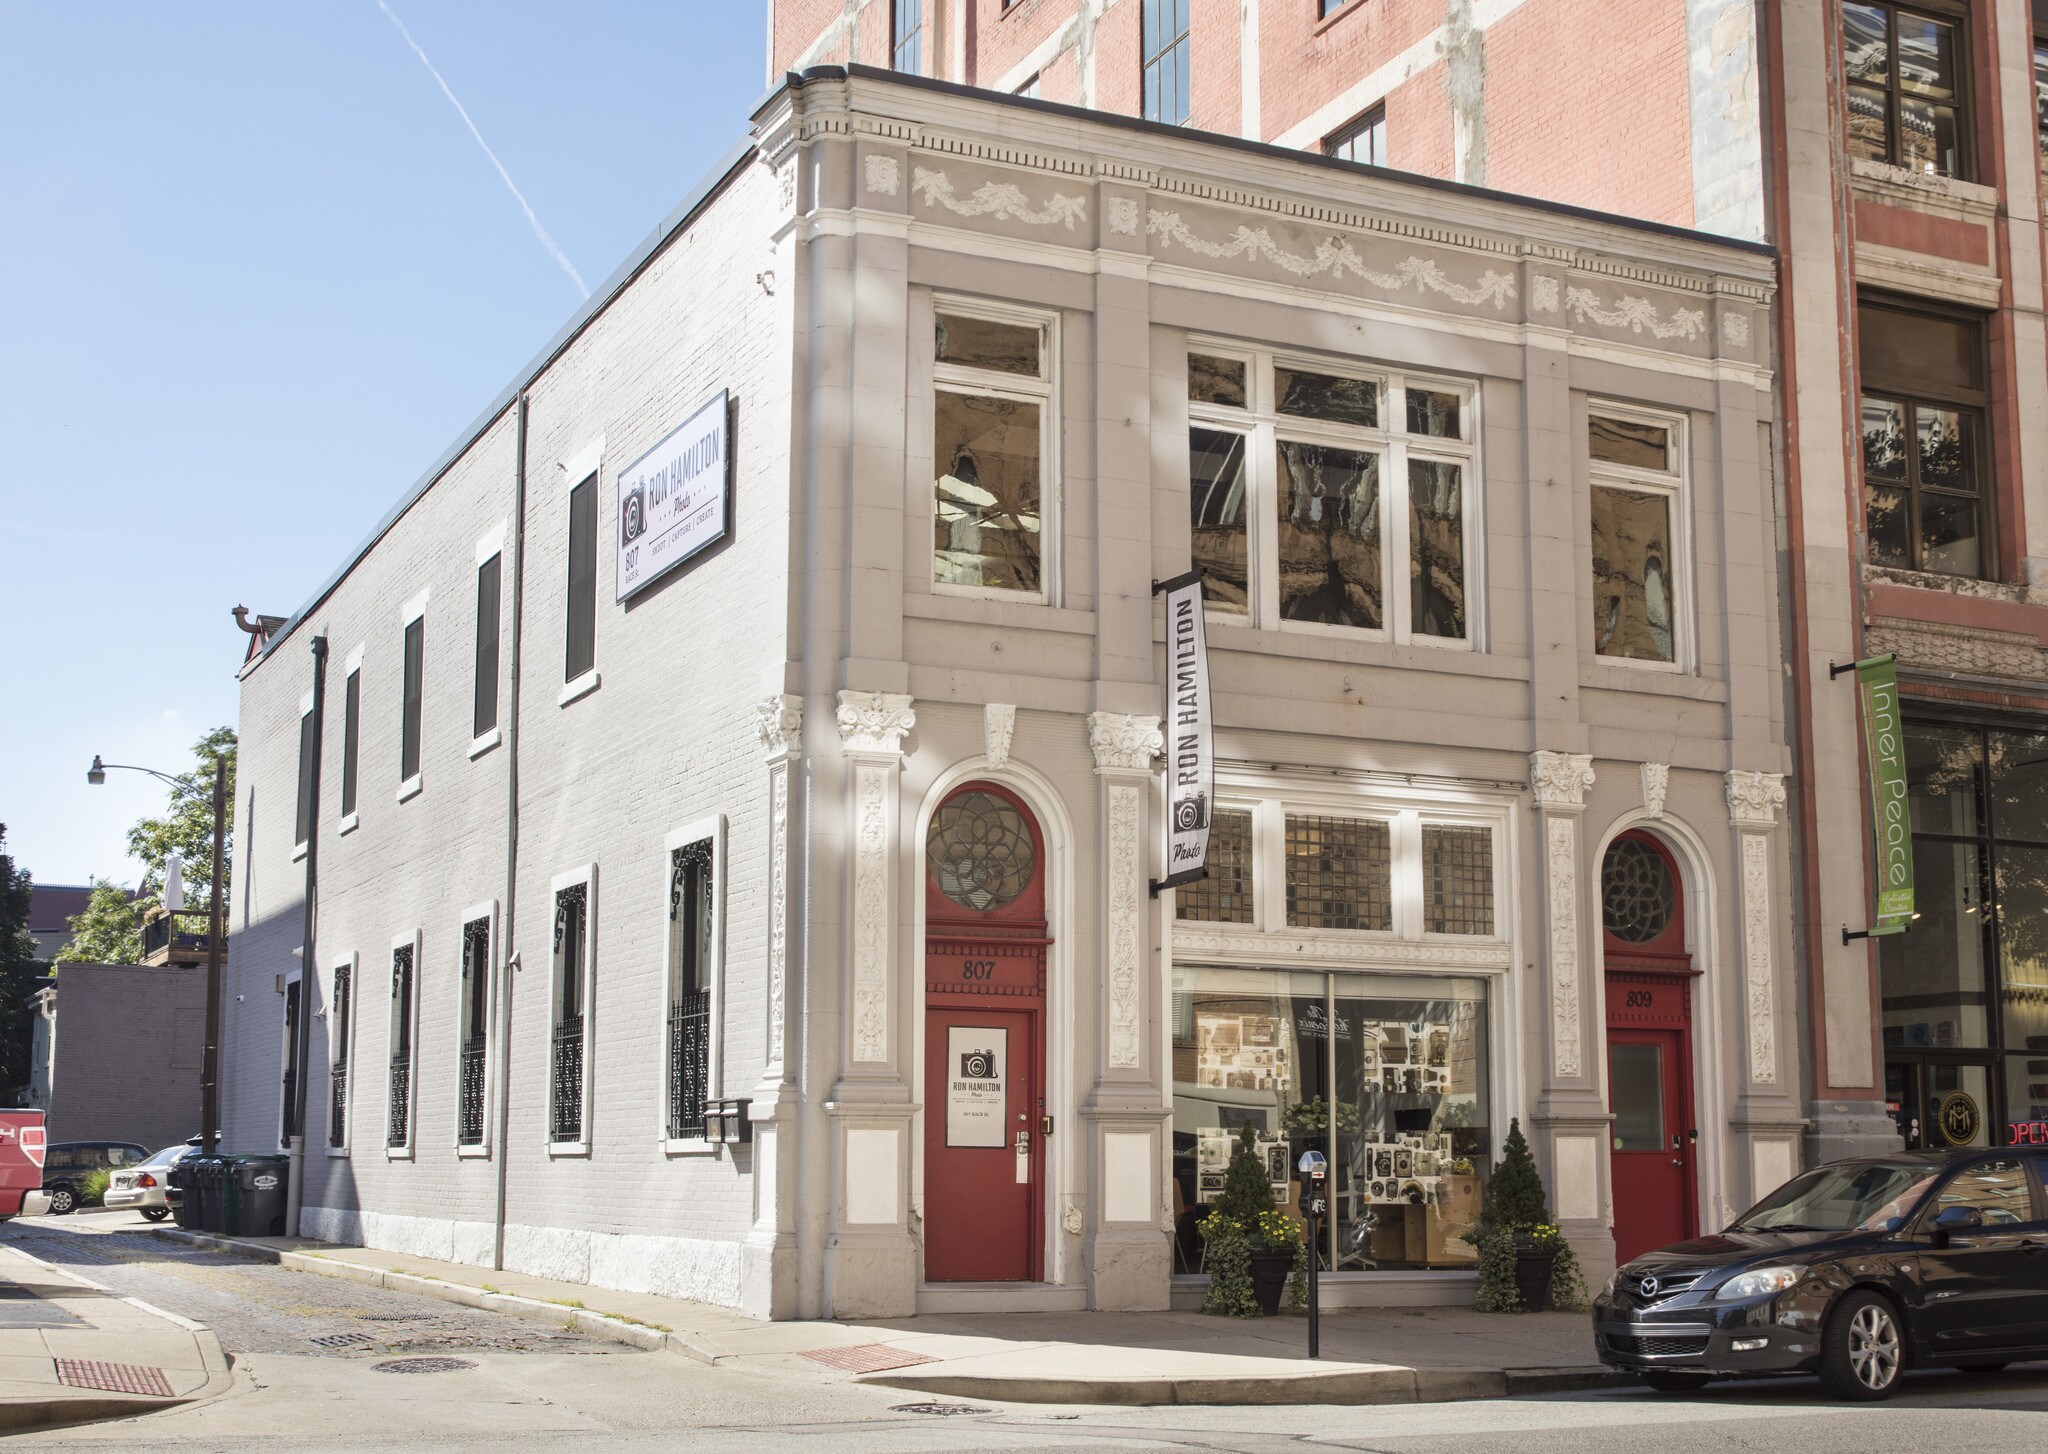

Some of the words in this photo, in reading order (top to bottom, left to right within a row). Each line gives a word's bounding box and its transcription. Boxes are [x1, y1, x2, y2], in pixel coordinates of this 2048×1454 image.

[649, 466, 668, 511] RON
[670, 426, 719, 495] HAMILTON
[673, 490, 691, 517] Photo
[651, 540, 666, 556] SHOOT
[671, 522, 692, 543] CAPTURE
[696, 507, 714, 526] CREATE
[625, 545, 639, 572] 807
[1176, 598, 1198, 727] HAMILTON
[1873, 682, 1897, 767] Inner
[1177, 733, 1199, 787] RON
[1883, 779, 1906, 886] Peace
[1173, 841, 1201, 863] Photo
[1882, 892, 1912, 903] Holistic
[1885, 902, 1908, 912] Center
[962, 960, 996, 981] 807
[1626, 990, 1653, 1008] 809
[953, 1081, 967, 1091] RON
[968, 1082, 1001, 1092] HAMILTON
